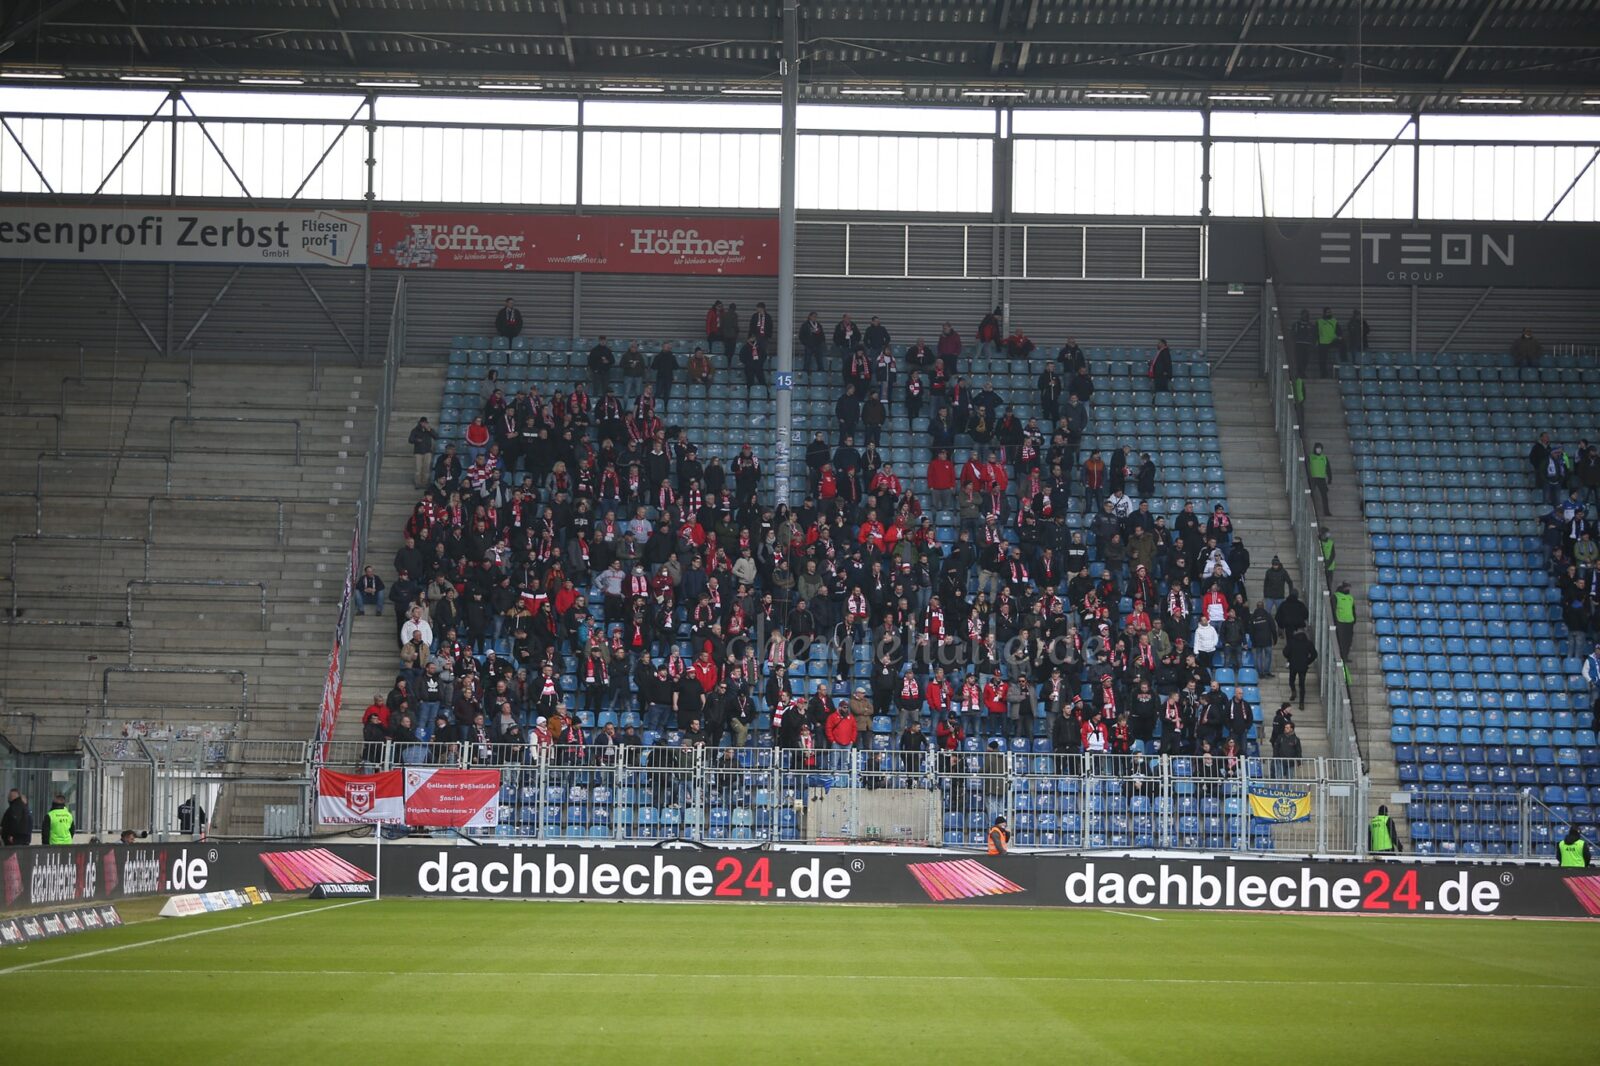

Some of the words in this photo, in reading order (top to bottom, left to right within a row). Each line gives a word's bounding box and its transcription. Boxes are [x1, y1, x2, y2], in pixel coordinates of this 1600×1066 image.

[177, 217, 290, 248] Zerbst
[302, 219, 348, 232] Fliesen
[262, 249, 289, 258] GmbH
[630, 229, 744, 255] Höffner
[1321, 232, 1514, 266] ETEON
[1387, 271, 1444, 281] GROUP
[777, 376, 792, 386] 15
[418, 851, 851, 899] dachbleche24.de
[1065, 862, 1501, 911] dachbleche24.de
